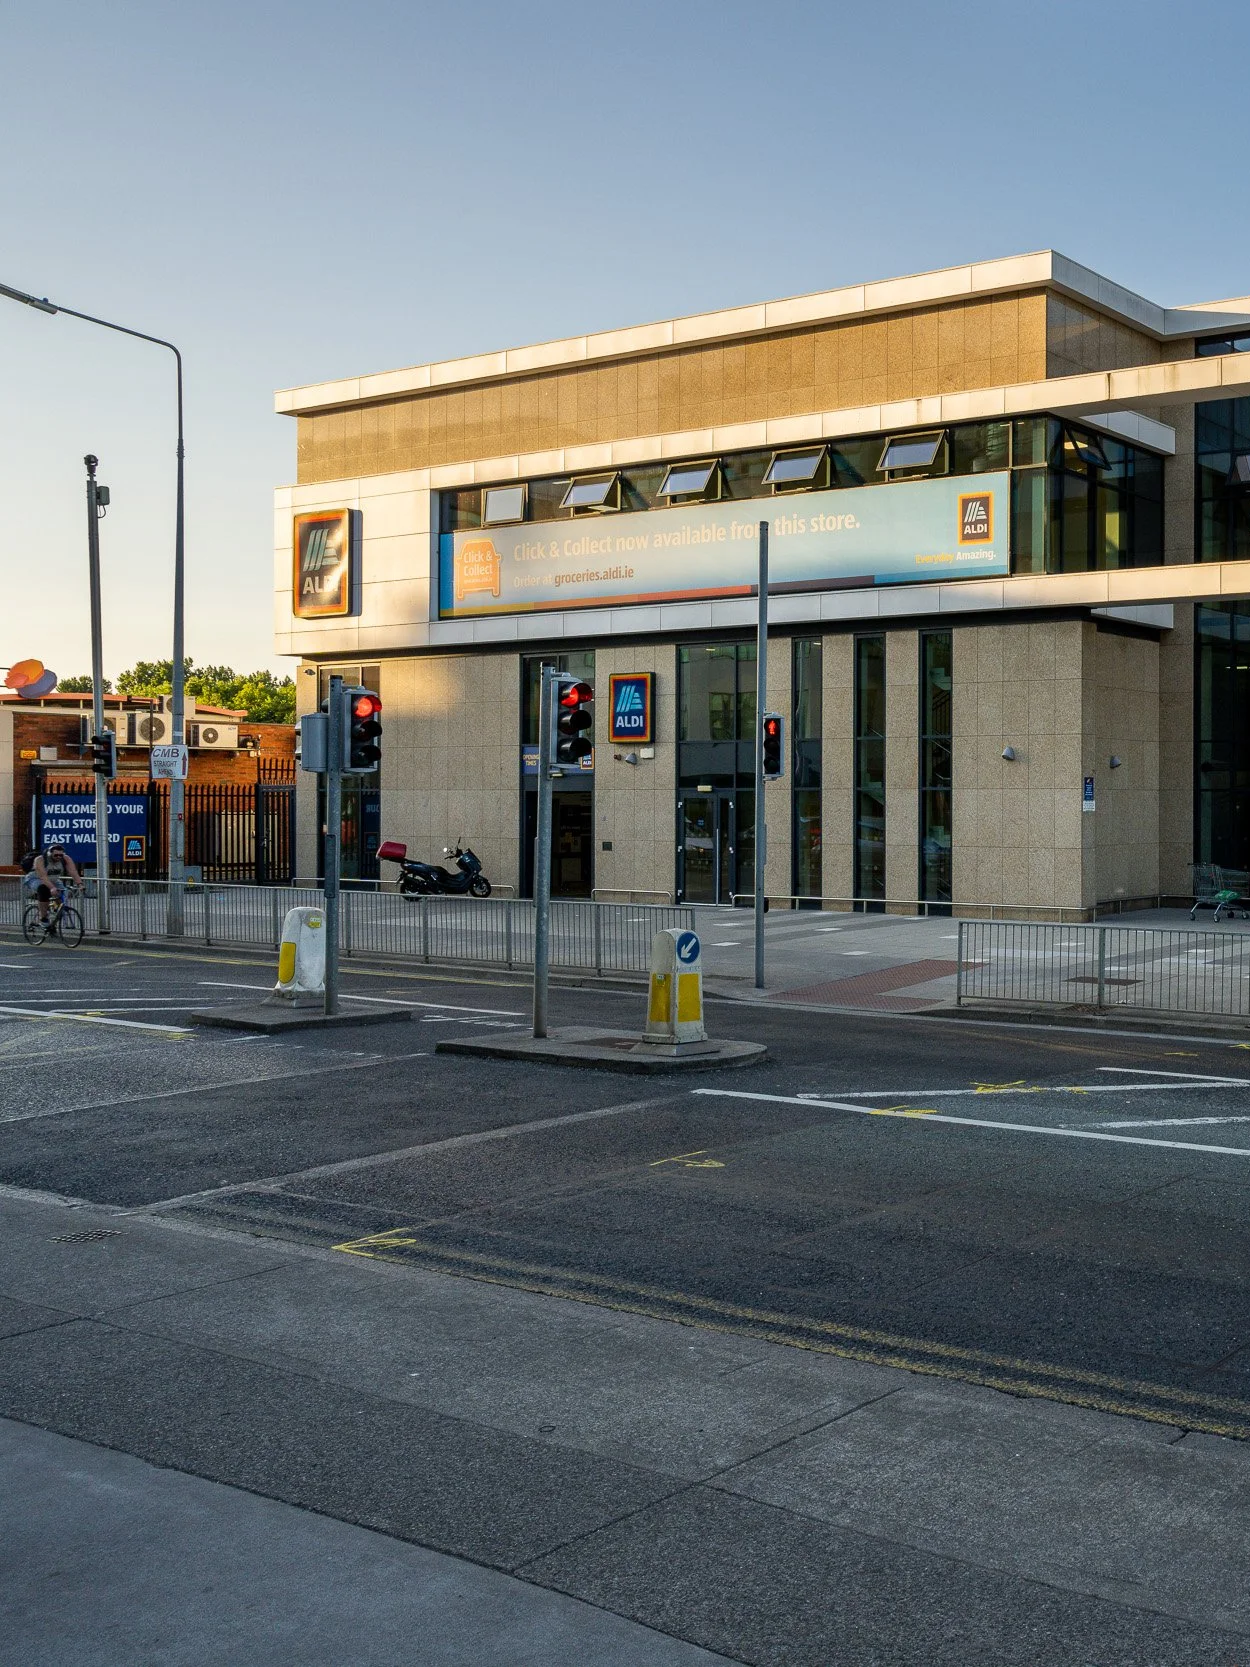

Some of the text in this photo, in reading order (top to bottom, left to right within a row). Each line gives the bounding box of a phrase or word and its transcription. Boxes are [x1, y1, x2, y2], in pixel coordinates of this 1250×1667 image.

[964, 523, 988, 534] ALDI
[513, 541, 545, 562] Click
[549, 541, 560, 557] &
[563, 536, 612, 557] Collect
[616, 535, 649, 552] now
[653, 523, 726, 548] available
[774, 514, 805, 536] this
[810, 512, 860, 533] store.
[464, 550, 493, 563] Click &
[956, 549, 996, 561] Amazing.
[464, 564, 493, 576] Collect
[514, 574, 541, 588] Order
[554, 565, 634, 587] groceries.aldi.ie
[616, 715, 644, 728] ALDI
[153, 748, 179, 758] CMB
[43, 804, 97, 814] WELCOME
[115, 804, 144, 814] YOUR
[43, 819, 97, 829] ALDI STOR
[43, 833, 72, 844] EAST
[74, 833, 97, 843] WAL
